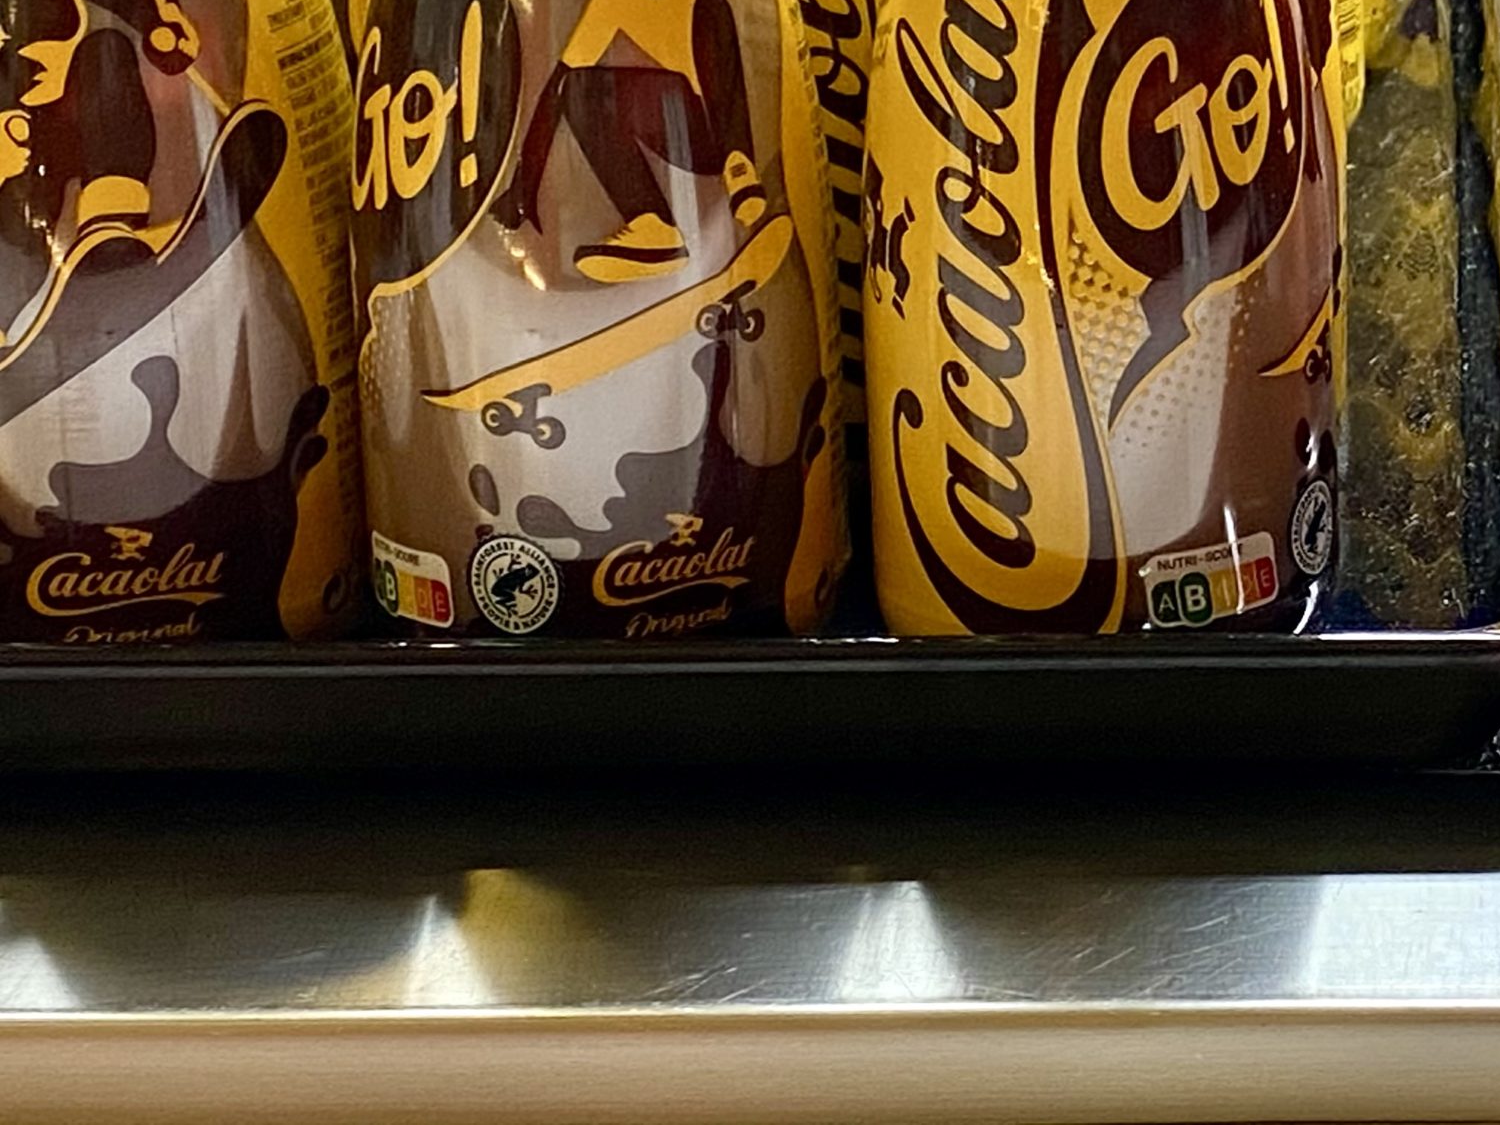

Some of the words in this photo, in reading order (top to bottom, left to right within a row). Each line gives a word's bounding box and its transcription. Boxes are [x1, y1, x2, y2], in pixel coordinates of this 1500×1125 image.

[26, 542, 226, 617] Cacaolat
[592, 527, 756, 607] Cacaolat
[1184, 583, 1208, 613] B
